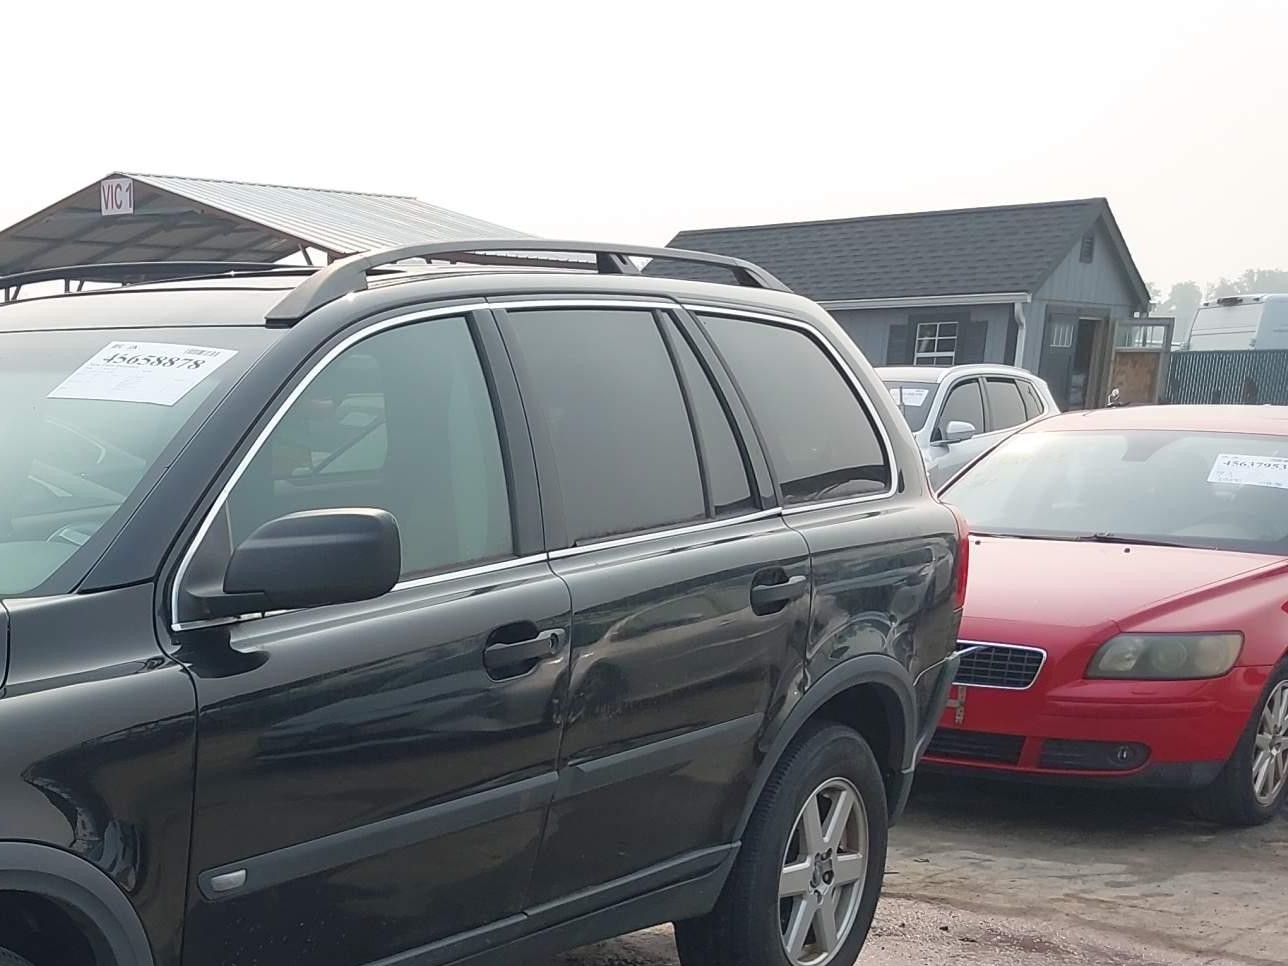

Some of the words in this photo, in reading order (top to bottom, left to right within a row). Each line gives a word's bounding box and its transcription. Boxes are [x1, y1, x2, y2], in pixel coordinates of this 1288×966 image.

[103, 184, 122, 210] VIC
[126, 183, 132, 208] 1
[103, 352, 206, 370] 45658878
